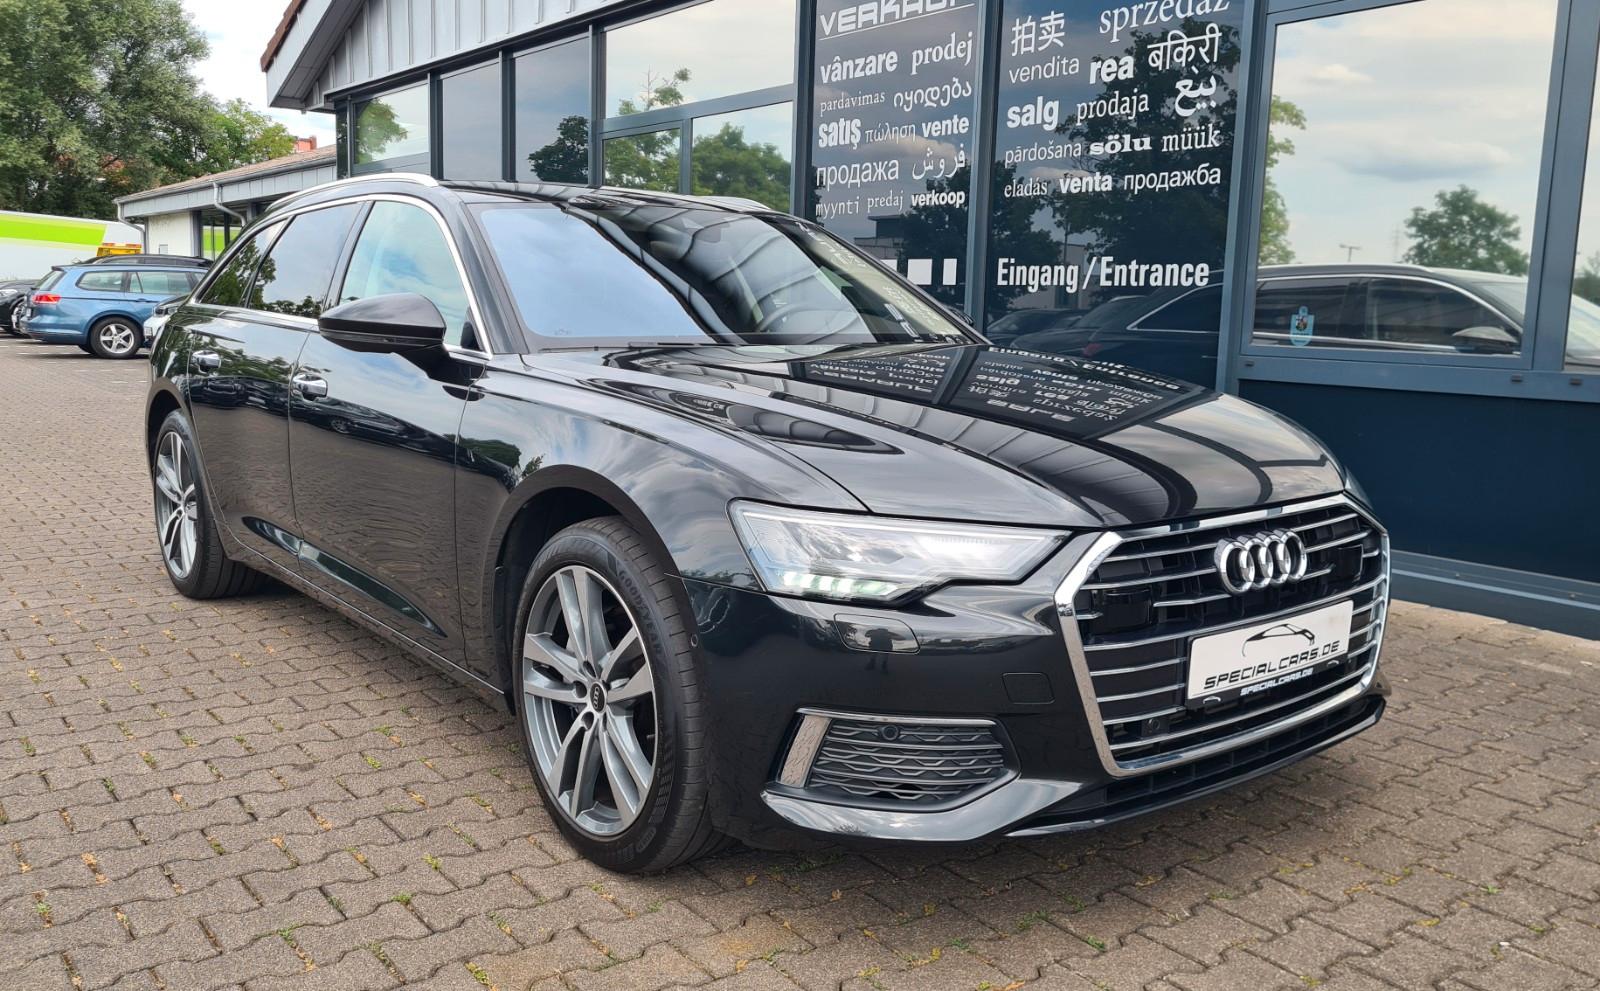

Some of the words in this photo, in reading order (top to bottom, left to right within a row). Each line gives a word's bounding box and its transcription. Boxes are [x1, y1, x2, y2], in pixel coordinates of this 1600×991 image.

[1010, 10, 1065, 57] 拍卖
[820, 50, 898, 84] vânzare
[910, 31, 973, 76] prodej
[1009, 55, 1080, 84] vendita
[1089, 55, 1135, 84] rea
[820, 90, 886, 117] pardavimas
[1006, 95, 1060, 131] salg
[1076, 88, 1150, 126] prodaja
[1174, 74, 1217, 117] بيع
[865, 122, 916, 144] πώληση
[922, 114, 970, 138] vente
[1004, 140, 1082, 168] pārdošana
[1089, 133, 1153, 155] sölu
[1161, 123, 1221, 152] müük
[816, 159, 899, 191] продажа
[1004, 178, 1048, 198] eladás
[1059, 171, 1113, 194] venta
[1123, 162, 1222, 195] продажба
[815, 195, 860, 221] myynti
[867, 189, 904, 213] predaj
[911, 190, 966, 208] verkoop
[1203, 640, 1341, 690] SPECIALCARS.DE
